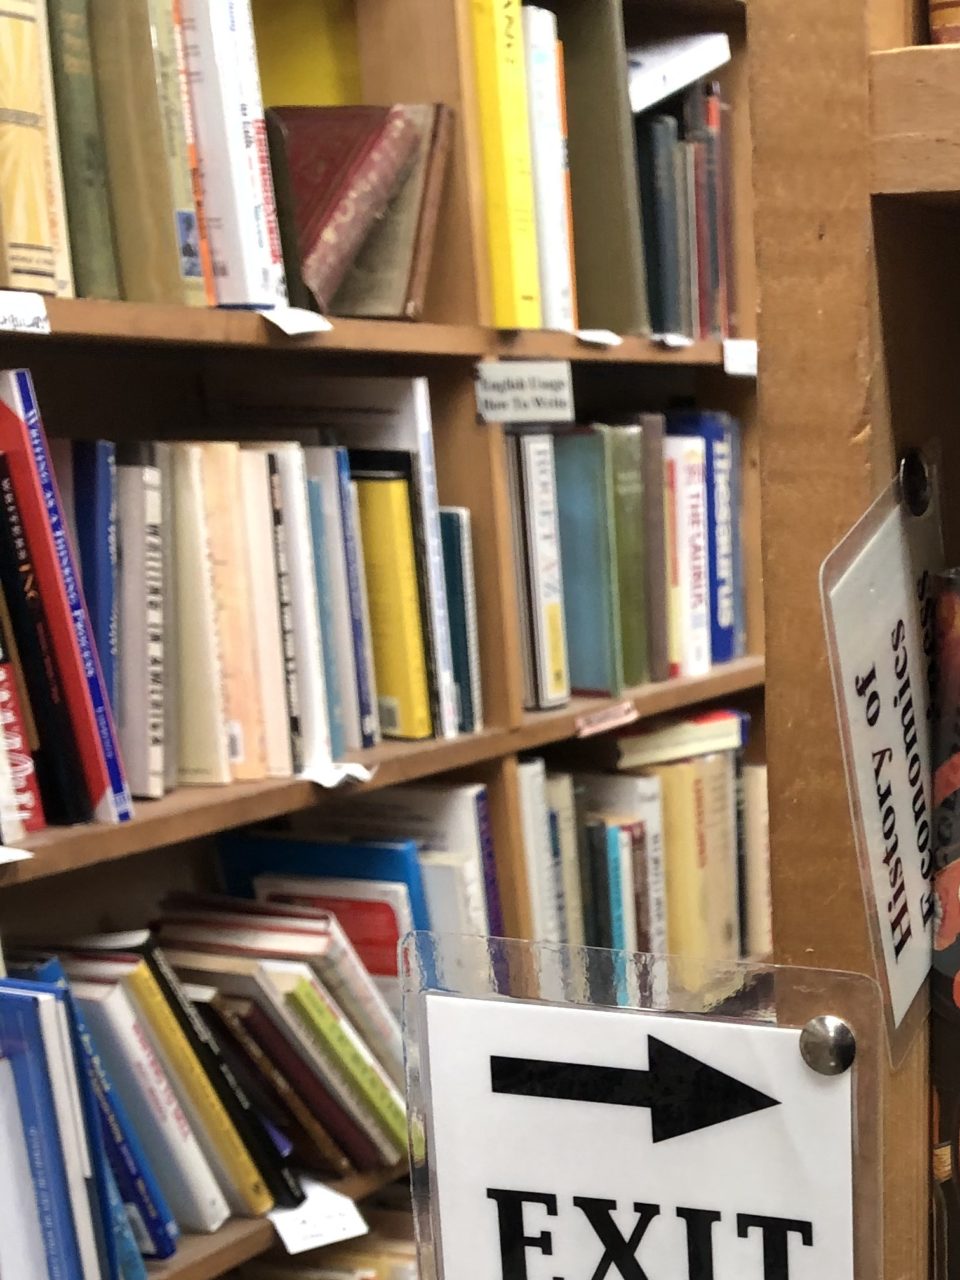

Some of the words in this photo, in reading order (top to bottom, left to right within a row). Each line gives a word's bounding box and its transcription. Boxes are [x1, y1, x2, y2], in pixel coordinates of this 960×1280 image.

[713, 440, 734, 629] Thesaurus
[855, 662, 882, 729] of
[891, 618, 936, 928] Economics
[871, 745, 913, 961] History
